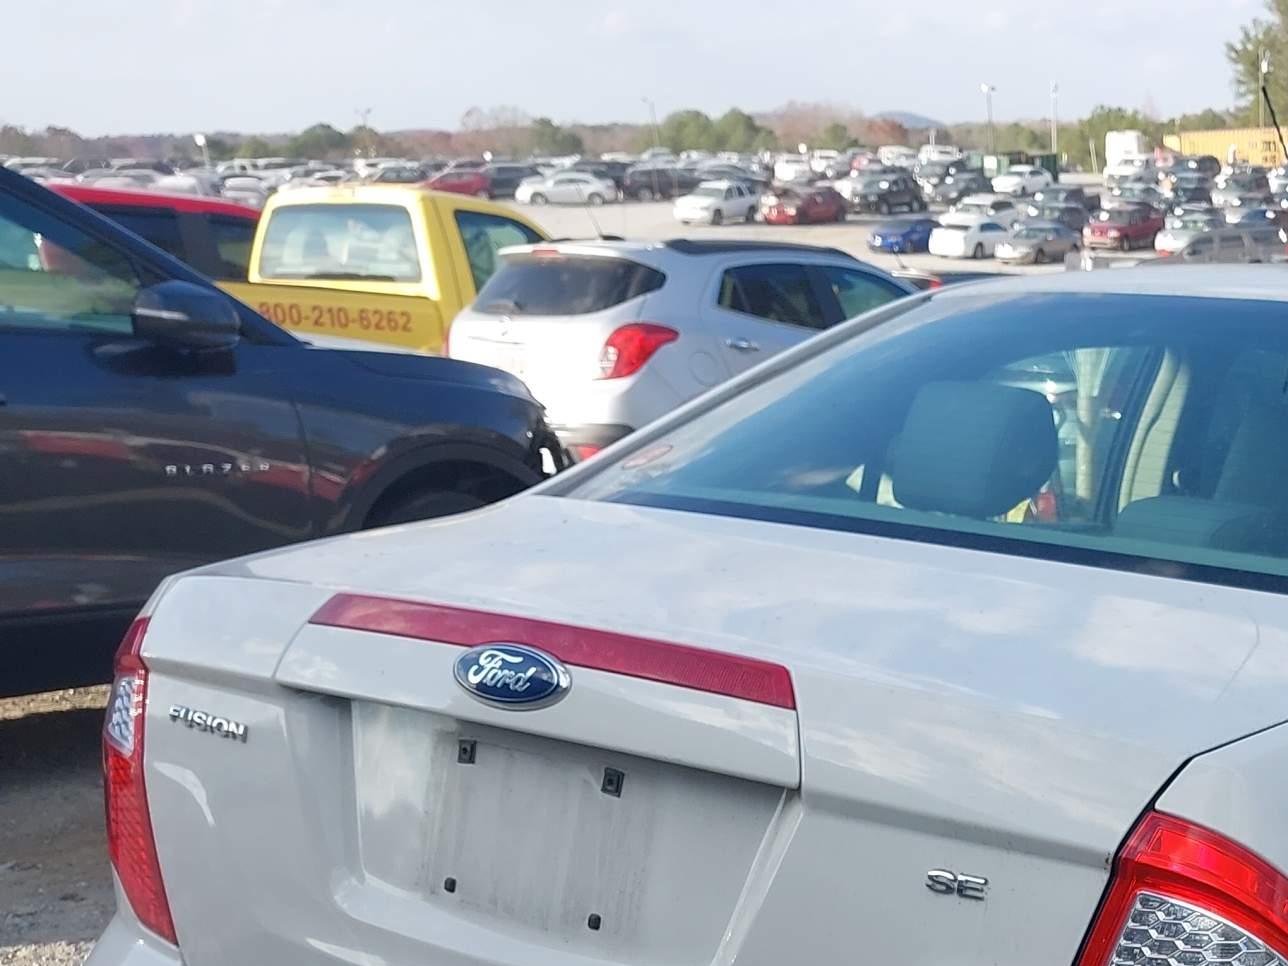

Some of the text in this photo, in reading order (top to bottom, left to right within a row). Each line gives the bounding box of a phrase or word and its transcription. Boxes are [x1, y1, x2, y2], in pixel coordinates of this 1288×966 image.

[467, 649, 537, 692] Ford
[168, 704, 249, 744] FUSION
[925, 868, 988, 902] SE
